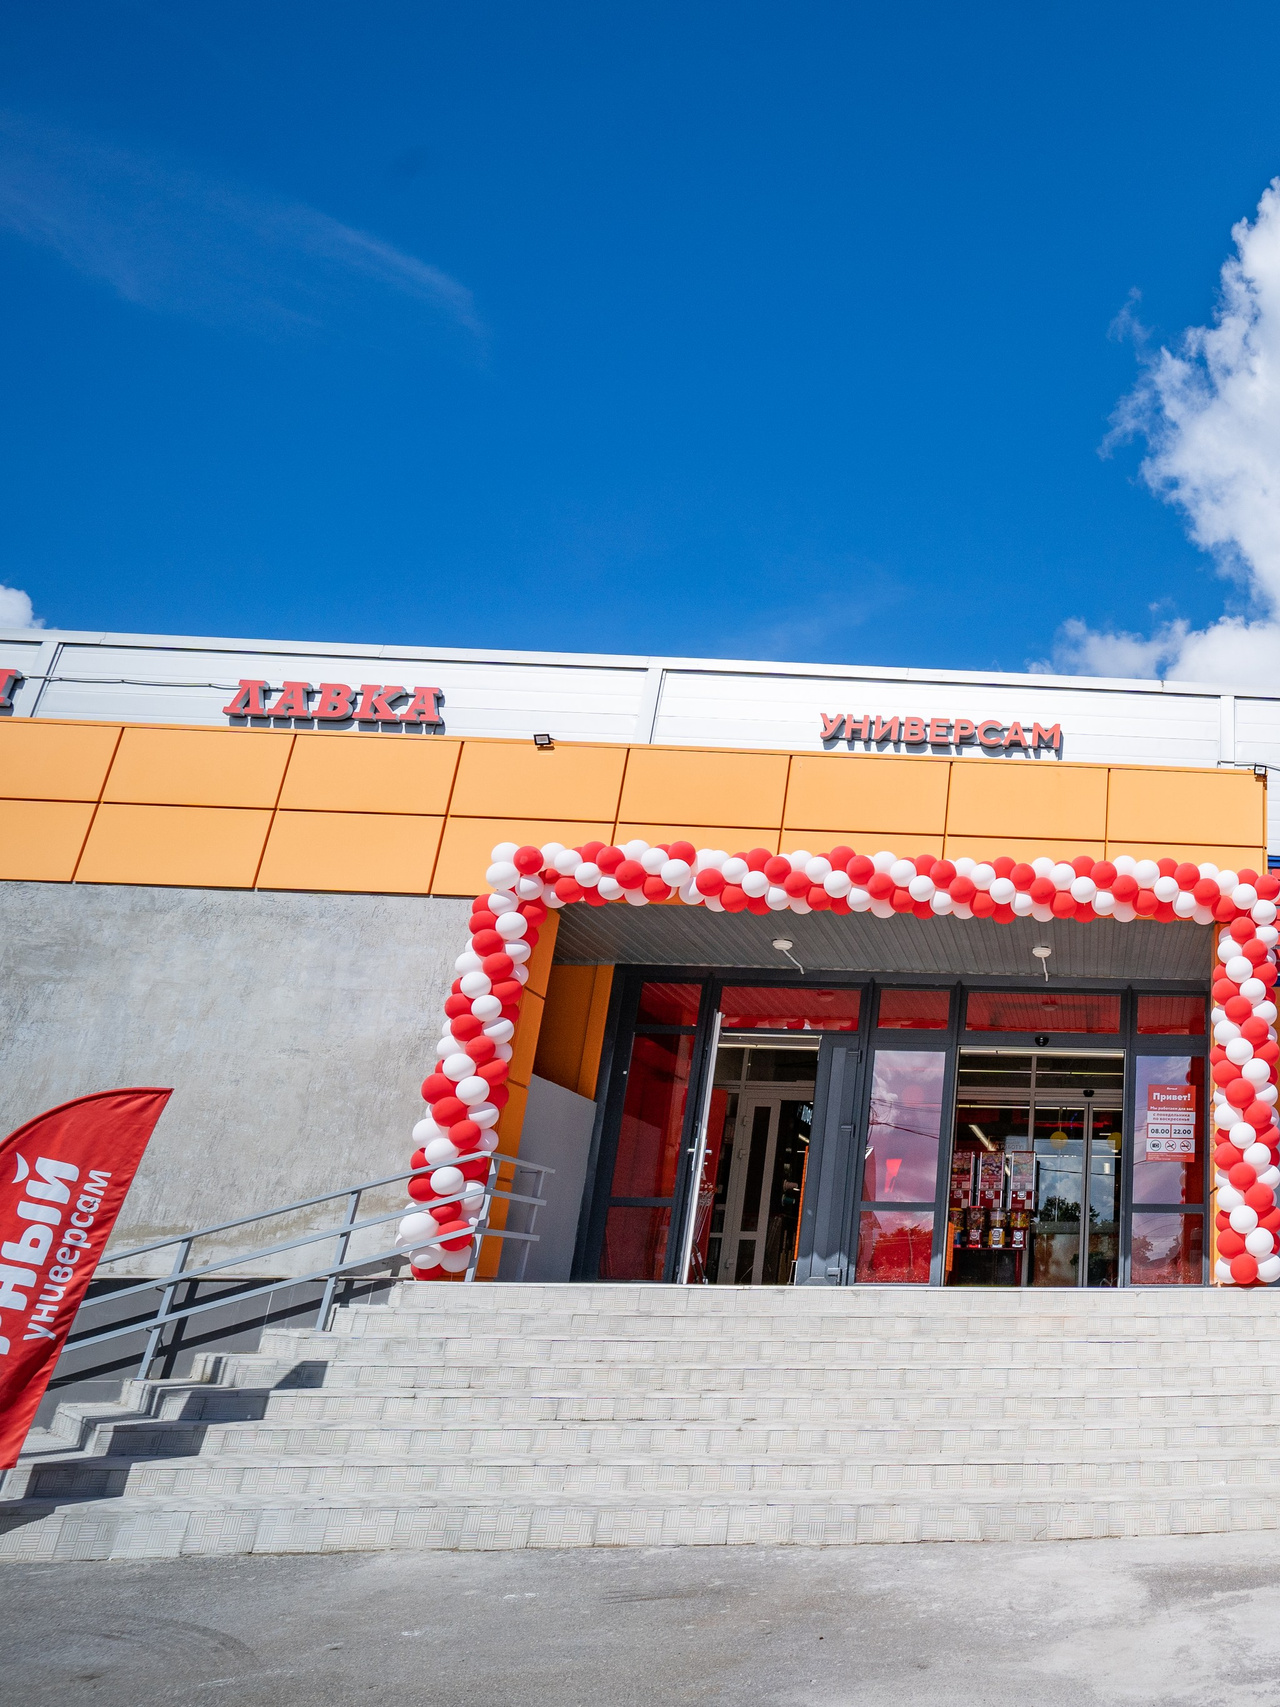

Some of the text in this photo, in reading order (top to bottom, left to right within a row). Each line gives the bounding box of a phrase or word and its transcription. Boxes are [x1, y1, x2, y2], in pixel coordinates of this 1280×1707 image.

[222, 679, 444, 725] ЛАВКА
[820, 713, 1061, 751] УНИВЕРСАМ
[1153, 1092, 1191, 1102] Привет!
[23, 1169, 112, 1341] универсам
